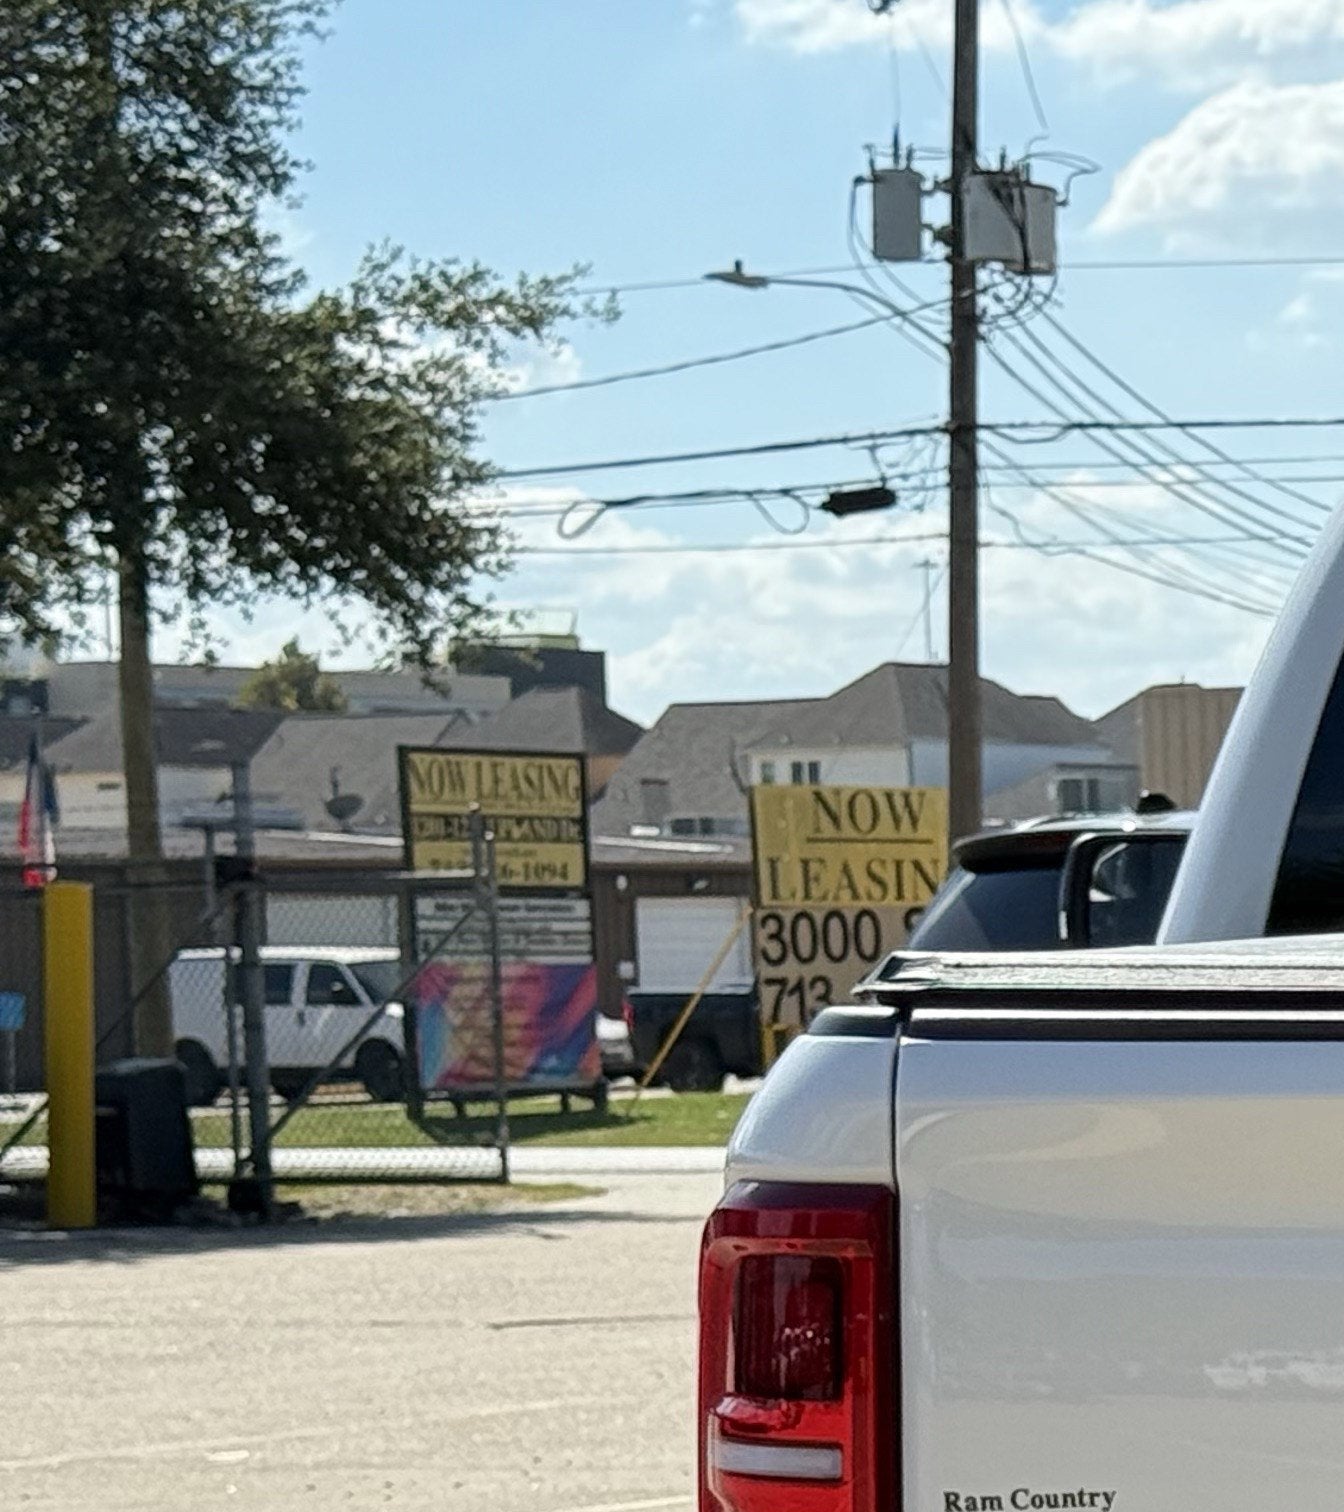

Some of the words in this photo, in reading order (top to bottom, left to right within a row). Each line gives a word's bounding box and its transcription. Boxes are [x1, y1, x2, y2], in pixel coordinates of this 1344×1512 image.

[410, 757, 466, 800] NOW
[474, 760, 581, 803] LEASING
[812, 789, 927, 835] NOW
[766, 856, 941, 902] LEASIN
[760, 909, 881, 966] 3000
[943, 1490, 1003, 1512] Ram
[1010, 1487, 1116, 1512] Country
